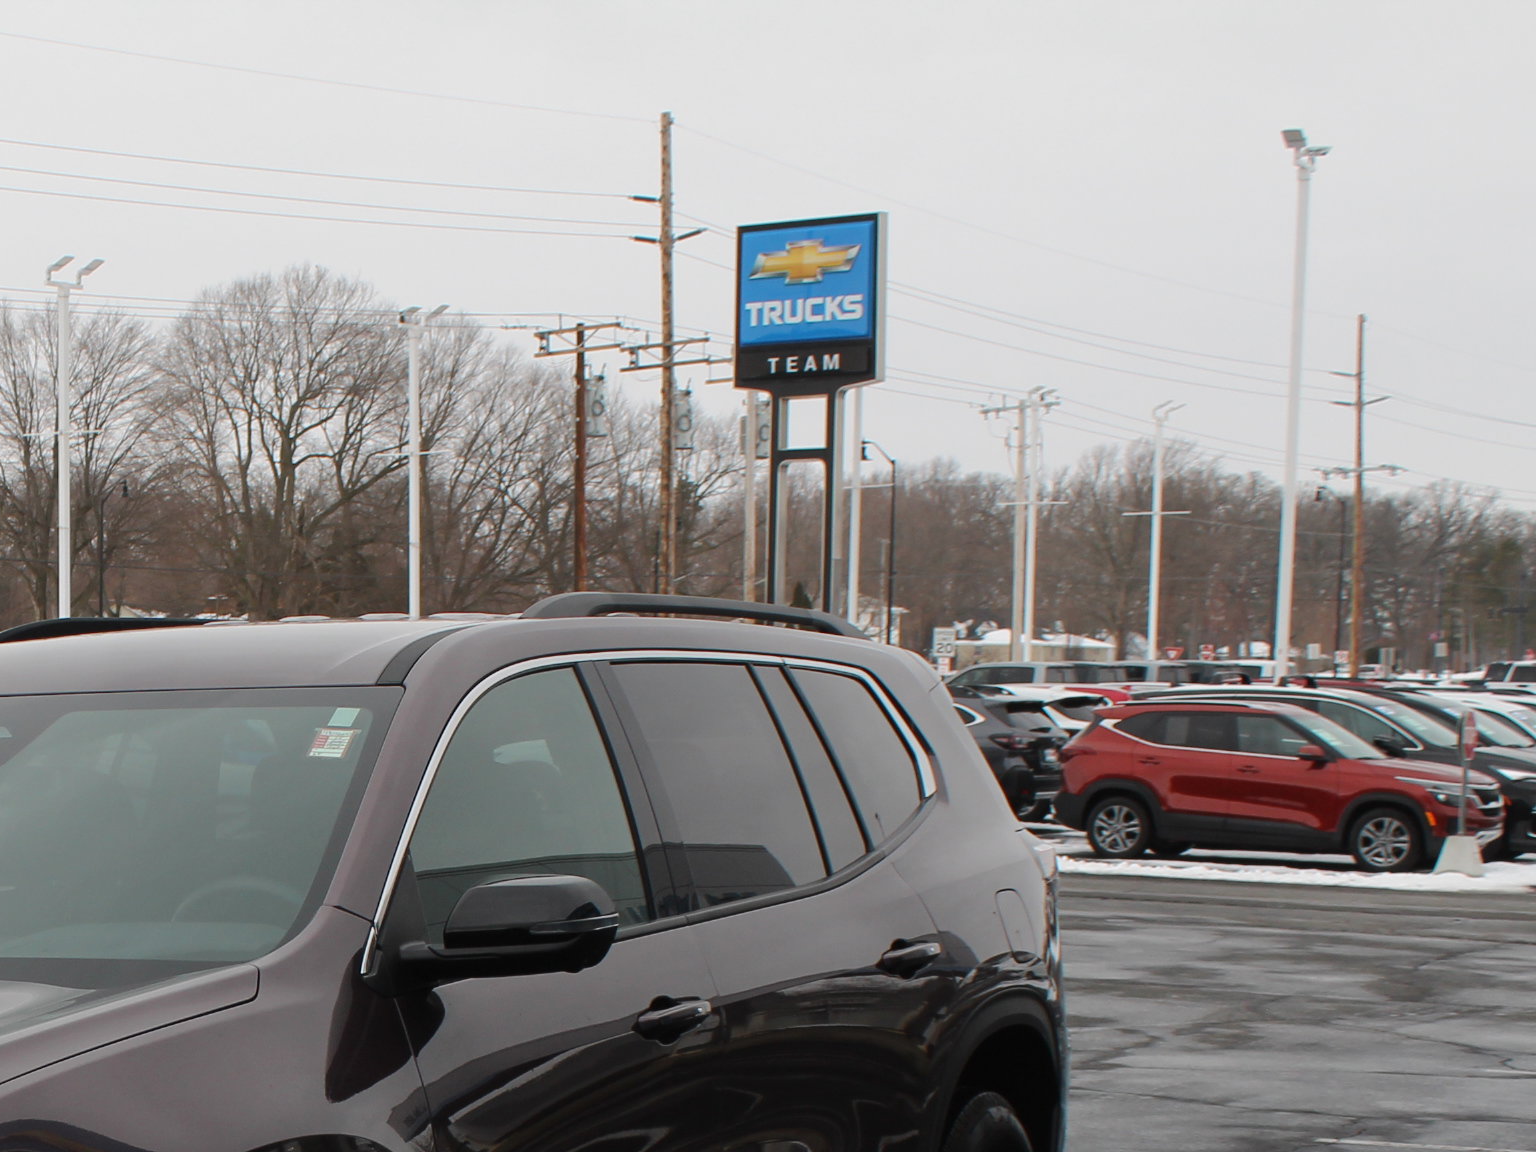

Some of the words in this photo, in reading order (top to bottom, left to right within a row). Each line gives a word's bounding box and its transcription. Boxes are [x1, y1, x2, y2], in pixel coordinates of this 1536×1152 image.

[745, 294, 864, 327] TRUCKS
[767, 353, 841, 374] TEAM
[936, 643, 953, 654] 20
